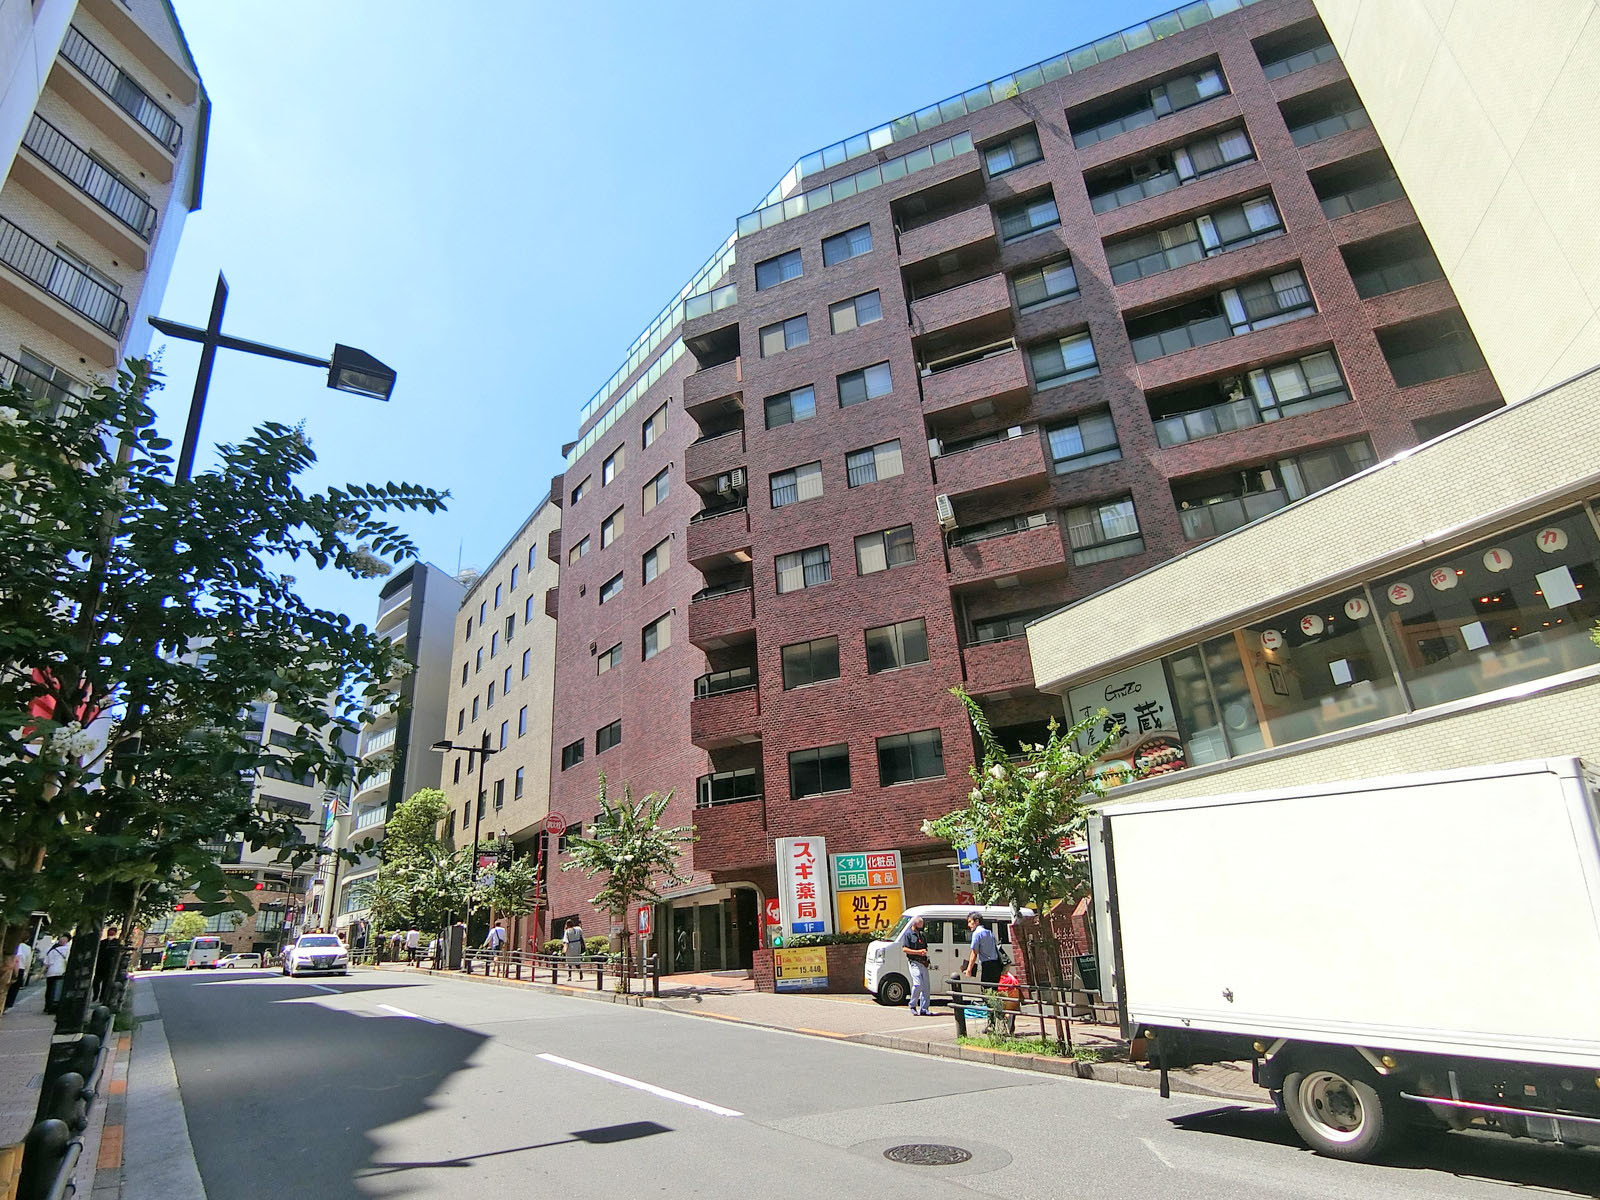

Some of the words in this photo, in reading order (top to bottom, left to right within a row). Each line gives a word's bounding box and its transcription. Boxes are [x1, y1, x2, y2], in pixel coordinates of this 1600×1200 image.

[838, 857, 864, 869] くすり
[868, 855, 895, 868] 化粧品
[793, 842, 817, 919] スギ薬局
[839, 873, 867, 886] 日用品
[872, 872, 894, 884] 食品
[852, 894, 888, 912] 処方
[803, 922, 815, 933] 1F
[853, 913, 890, 930] せん
